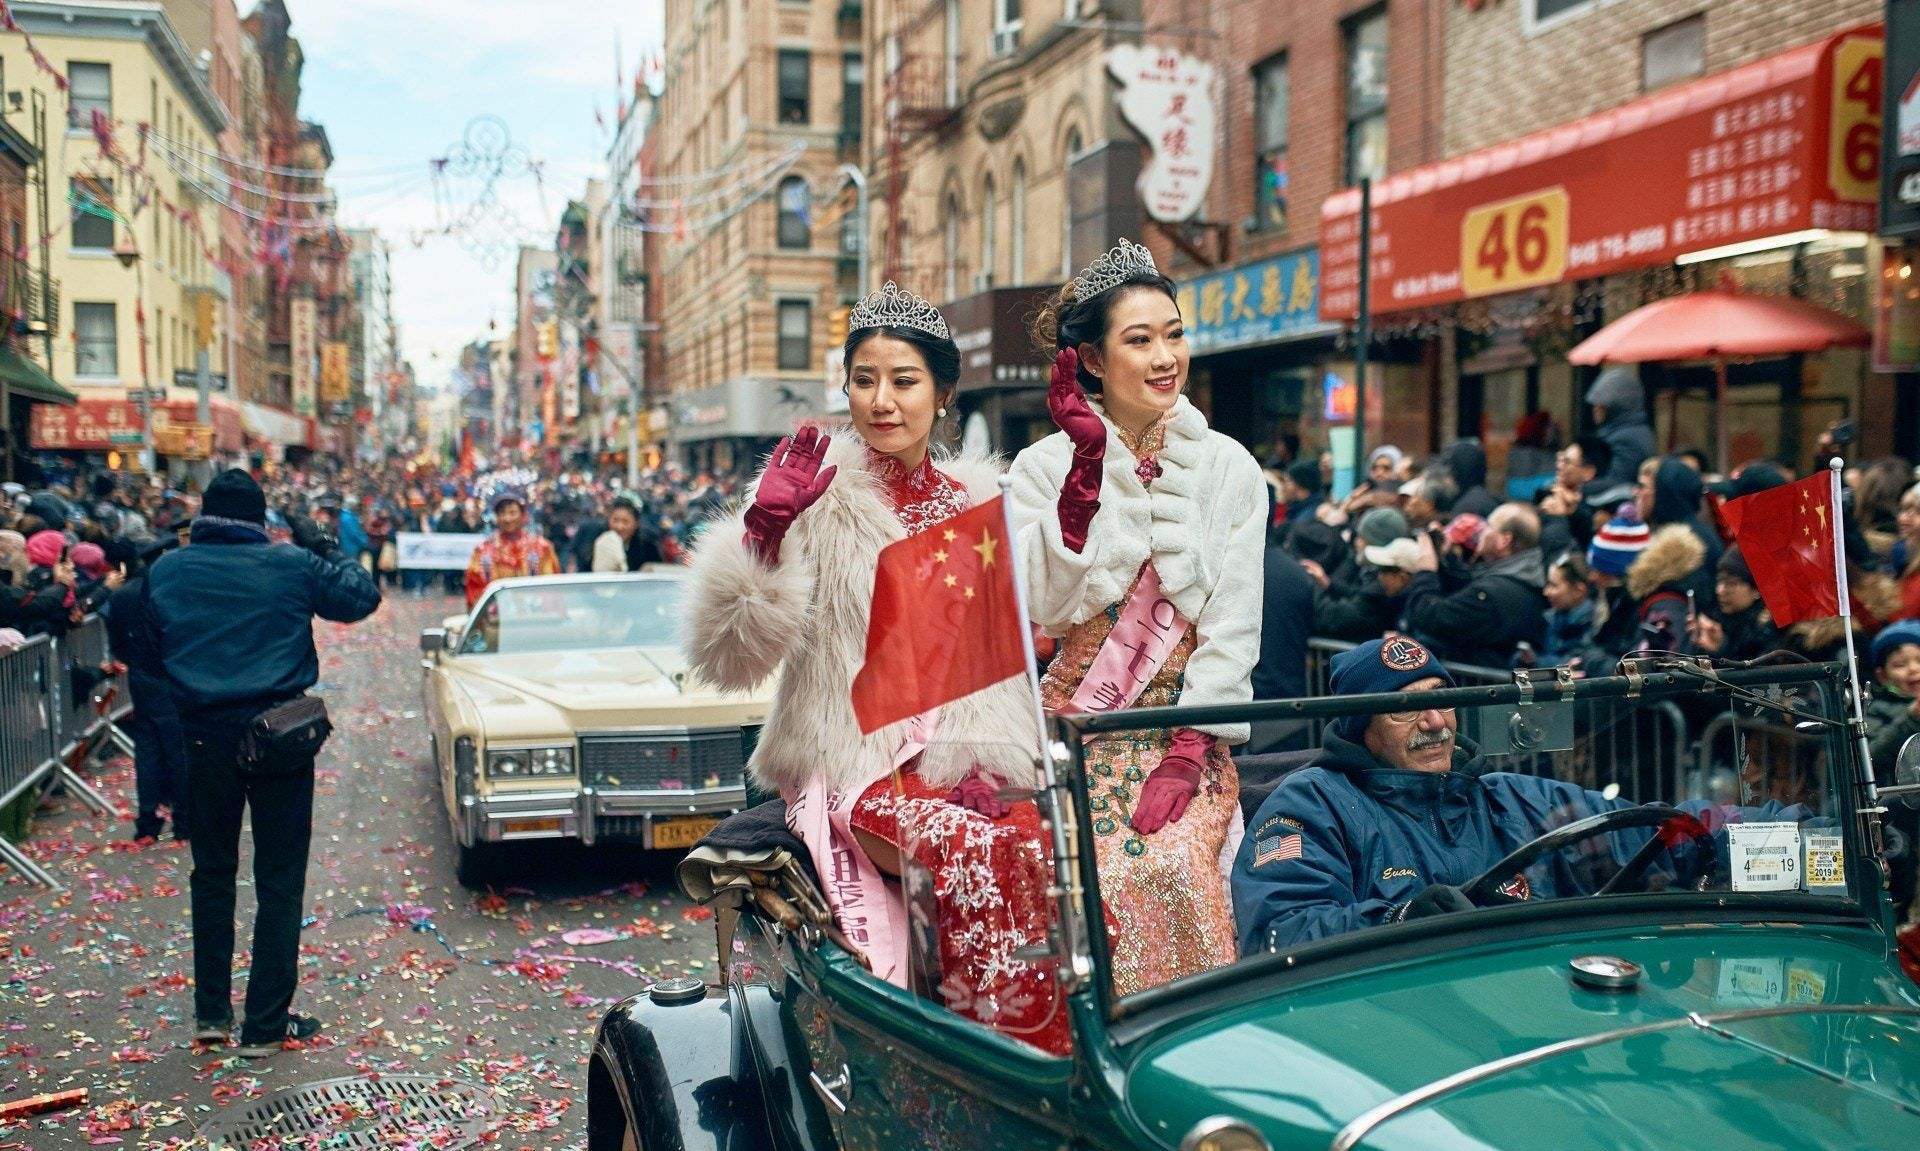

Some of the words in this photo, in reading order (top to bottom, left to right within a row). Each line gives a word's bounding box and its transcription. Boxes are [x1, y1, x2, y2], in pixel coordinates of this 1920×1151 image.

[1478, 203, 1548, 279] 46
[1280, 817, 1304, 831] AMERICA
[1744, 859, 1750, 873] 4
[1781, 858, 1794, 872] 19
[1815, 868, 1832, 877] 2019
